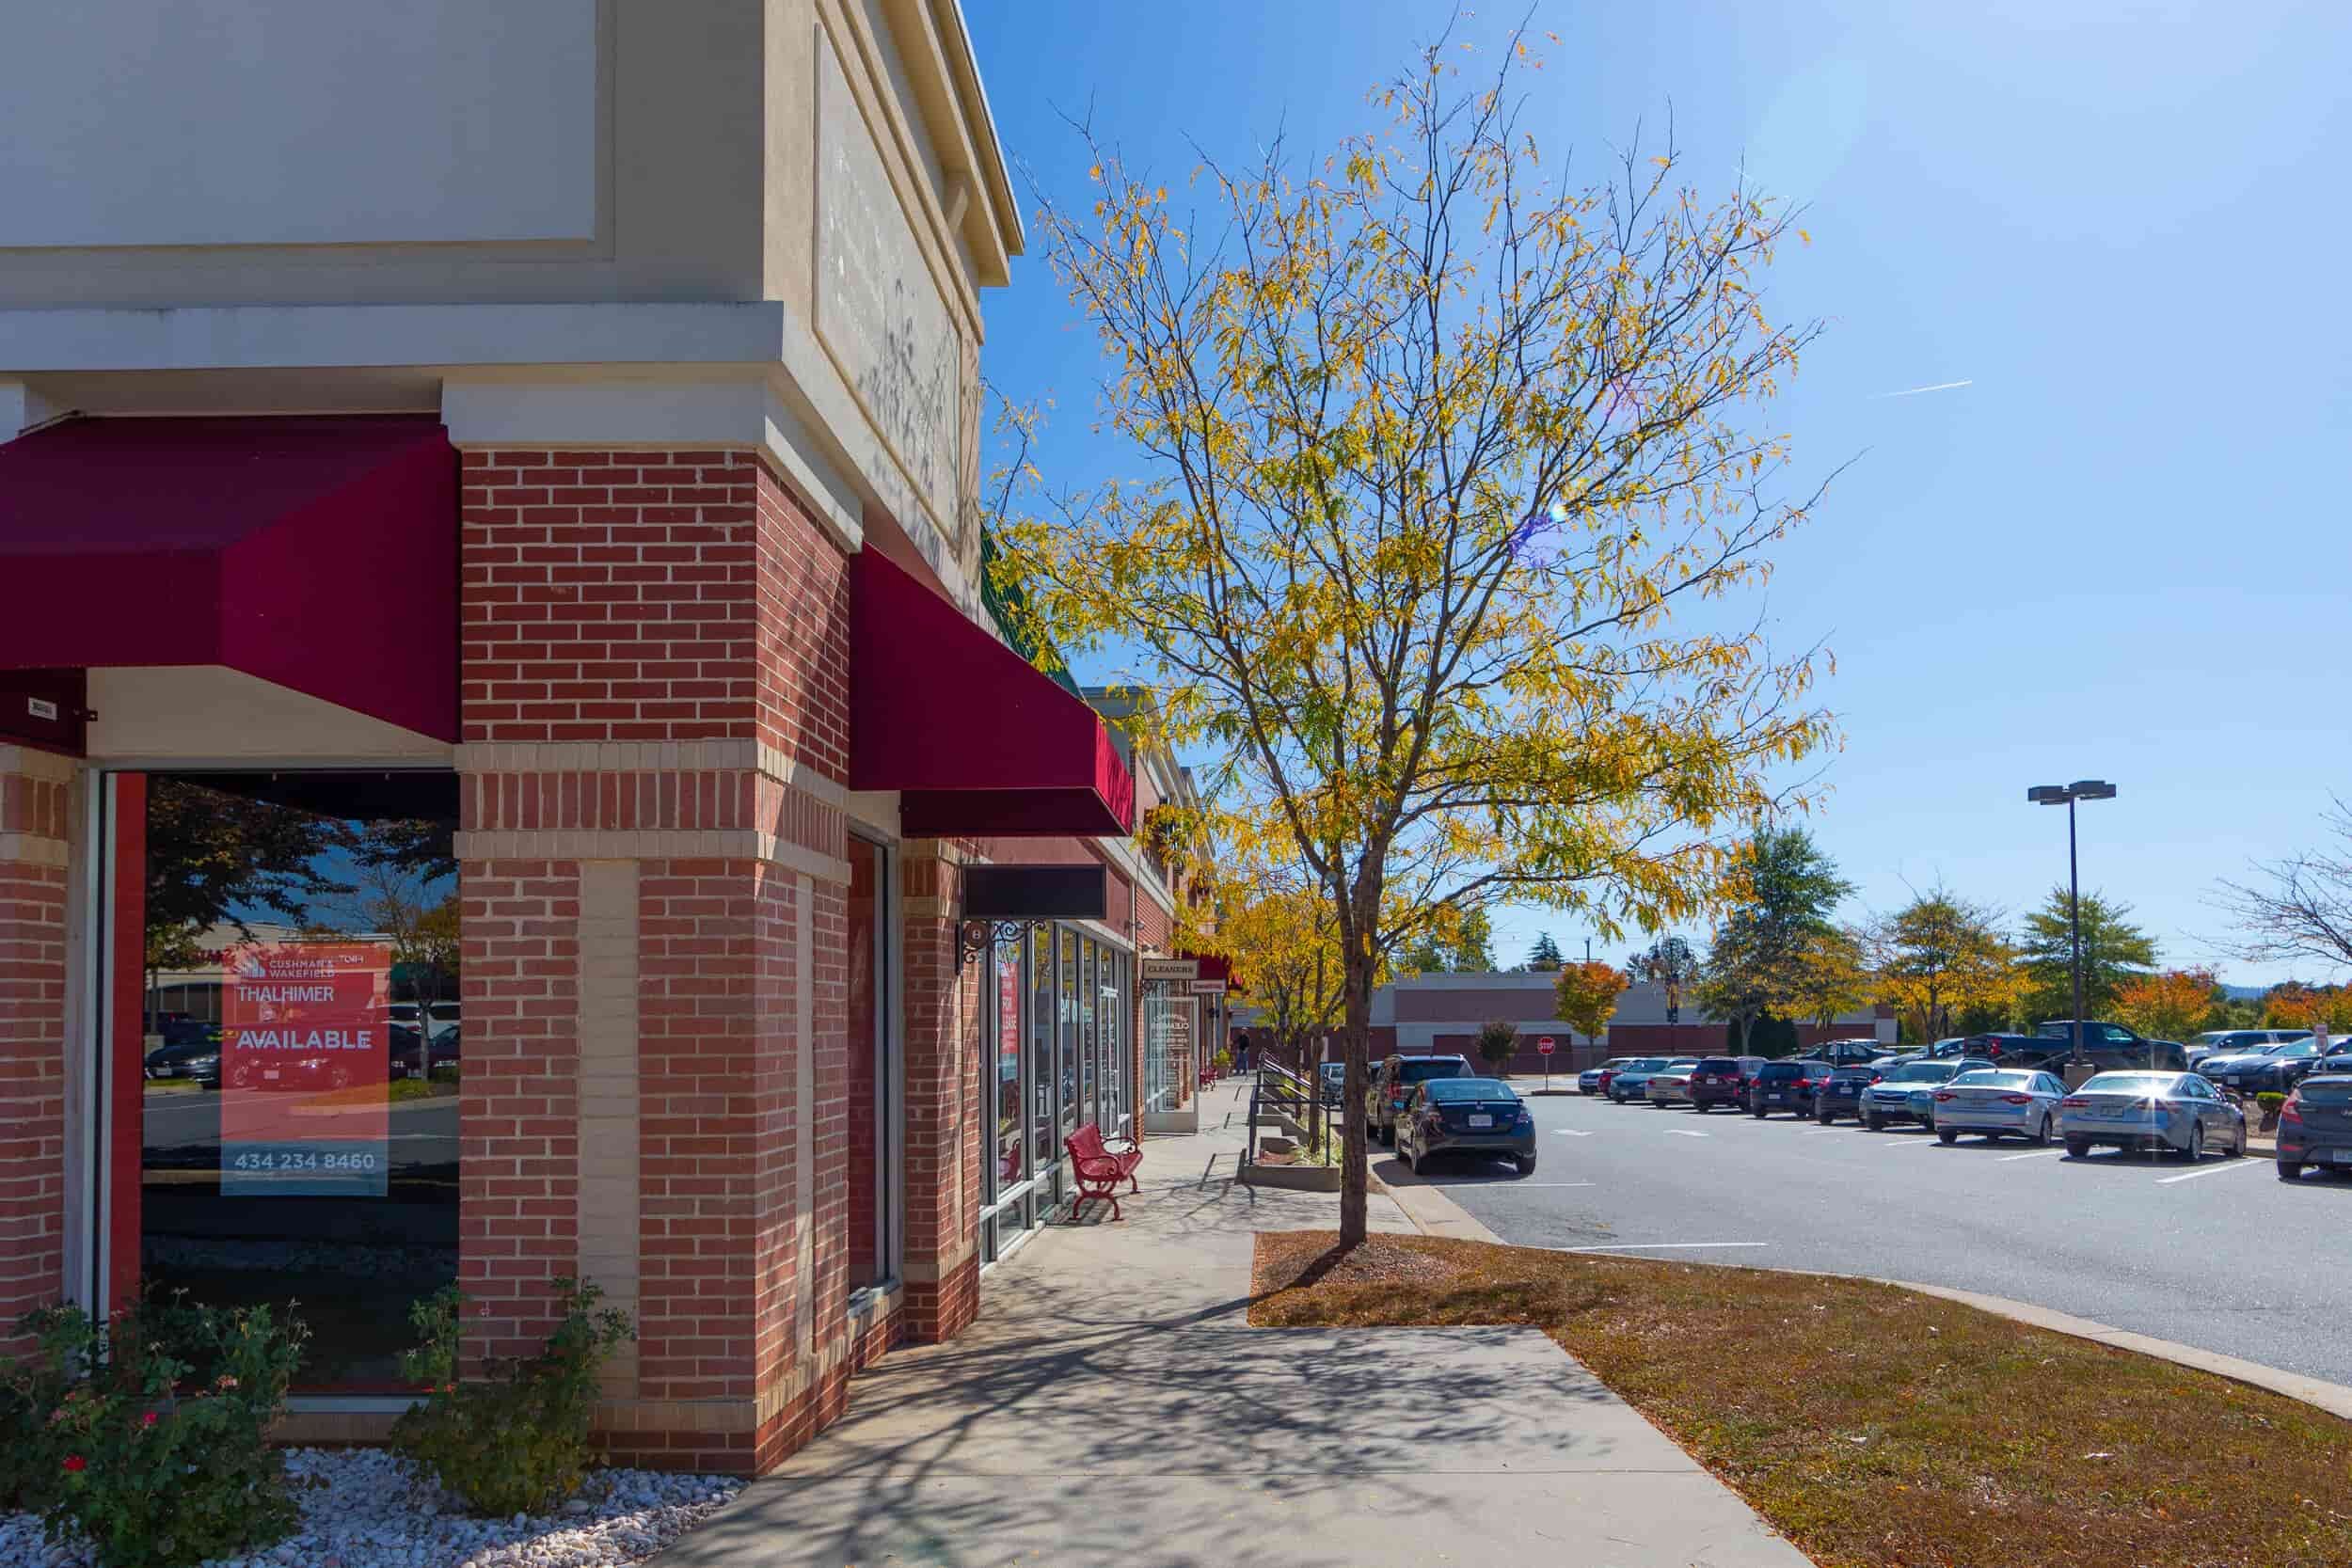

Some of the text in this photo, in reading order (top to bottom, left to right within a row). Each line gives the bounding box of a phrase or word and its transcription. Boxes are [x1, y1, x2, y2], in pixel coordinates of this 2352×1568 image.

[269, 970, 336, 978] WAKEFIELD
[1148, 965, 1193, 974] CLEANERS
[239, 987, 334, 1002] THALHIMER
[236, 1031, 373, 1050] AVAILABLE
[235, 1153, 374, 1169] 434 234 8460
